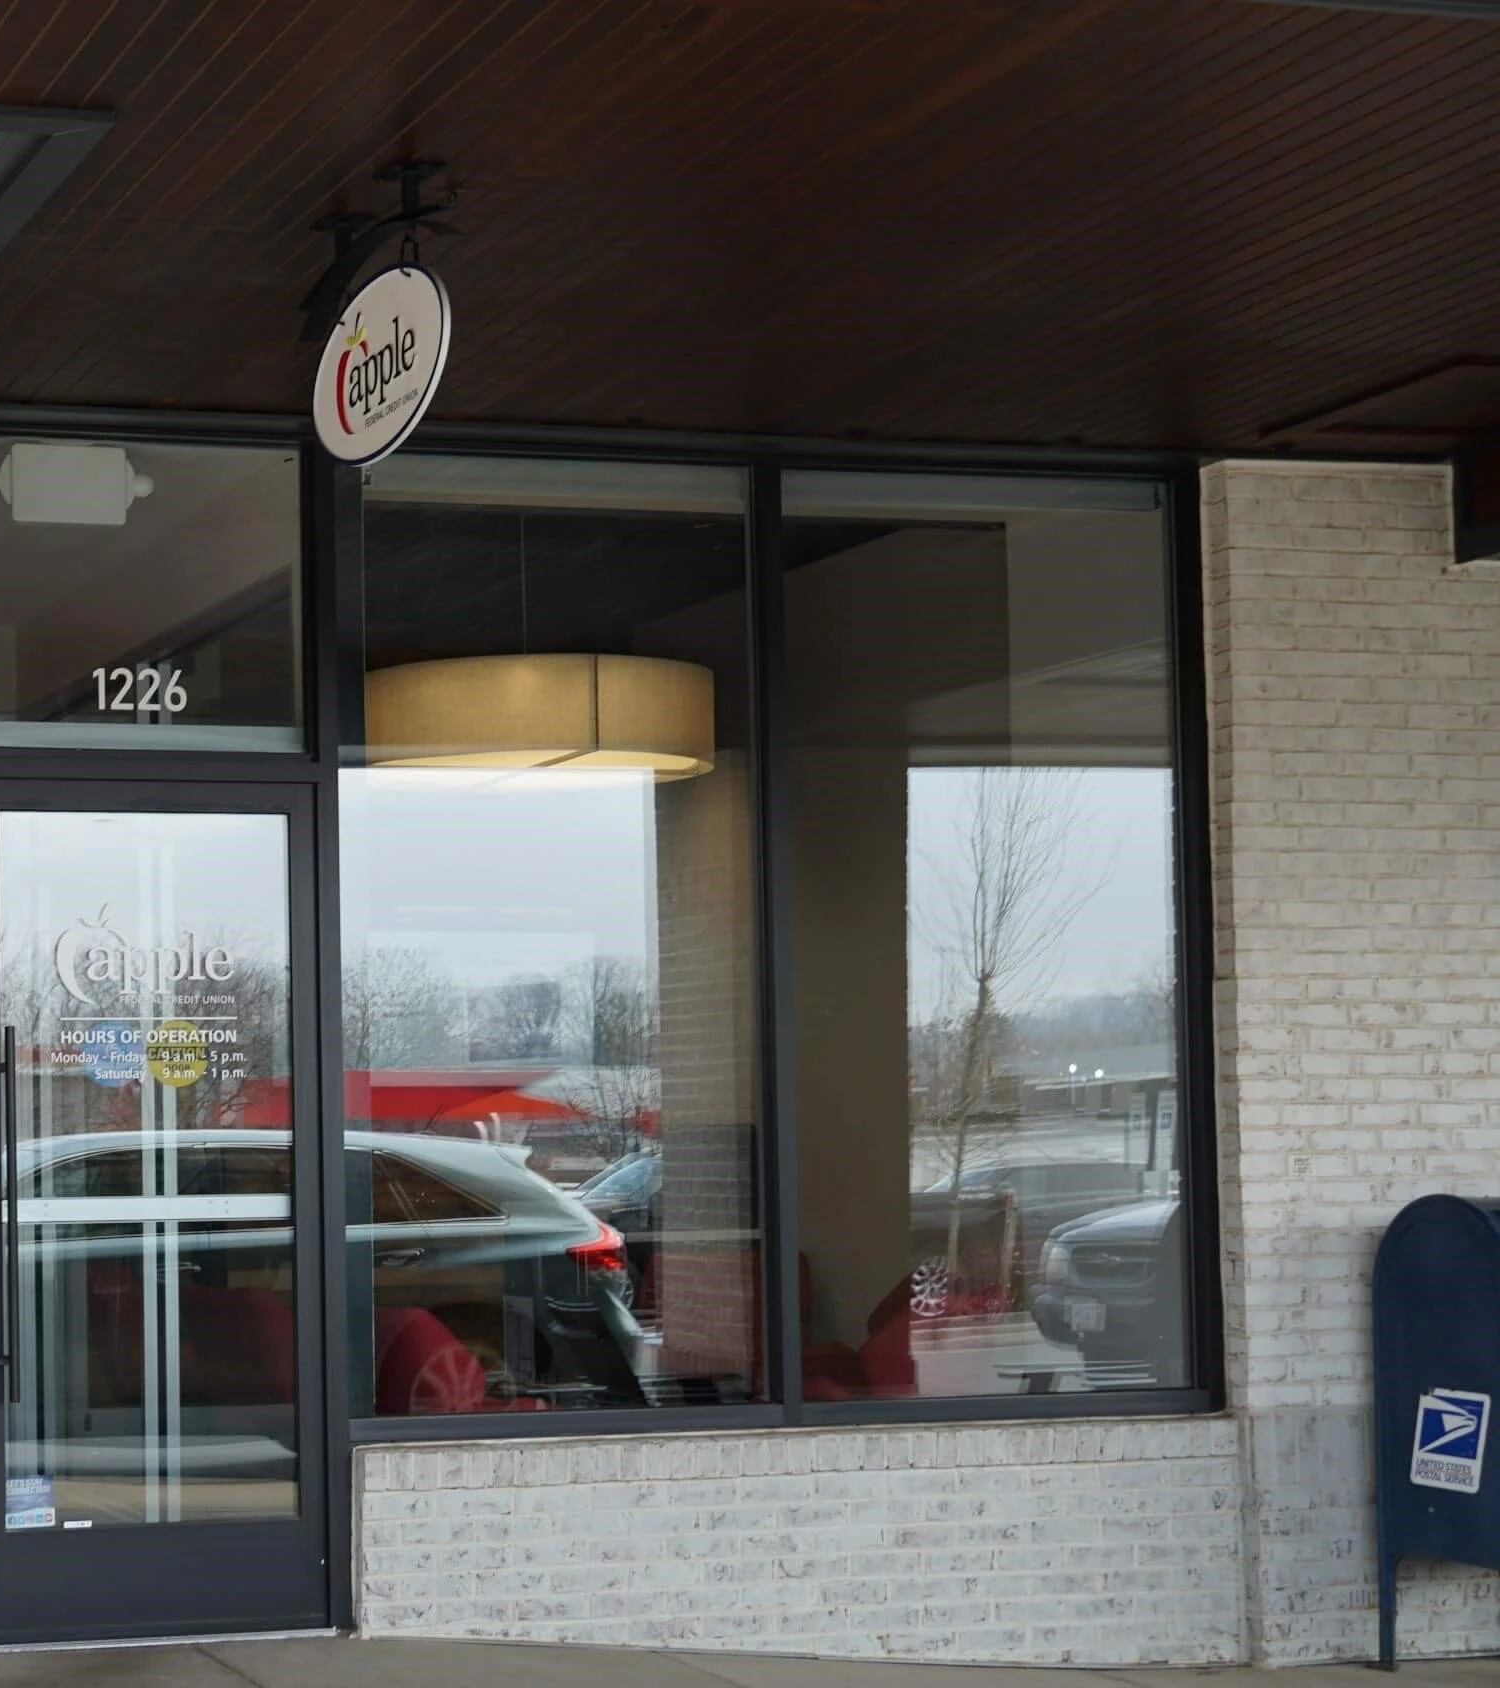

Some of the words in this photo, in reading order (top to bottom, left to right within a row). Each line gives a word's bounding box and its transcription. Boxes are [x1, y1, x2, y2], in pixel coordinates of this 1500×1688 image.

[349, 316, 416, 415] apple
[364, 410, 385, 428] FEDERAL
[385, 397, 402, 418] CREDIT
[402, 388, 419, 408] UNION
[92, 667, 188, 712] 1226
[86, 931, 235, 995] apple
[119, 995, 163, 1005] FEDAL
[202, 995, 235, 1004] UNION
[60, 1030, 116, 1044] HOURS
[120, 1030, 141, 1043] OF
[147, 1029, 237, 1043] OPERATION
[51, 1051, 99, 1065] Monday
[110, 1051, 147, 1065] Friday
[162, 1051, 169, 1062] 9
[210, 1051, 217, 1062] 5
[221, 1052, 247, 1064] p.m.
[95, 1068, 147, 1083] Saturday
[162, 1068, 169, 1079] 9
[173, 1069, 198, 1079] a.m.
[211, 1068, 217, 1078] 1
[221, 1069, 247, 1080] p.m.
[1415, 1457, 1444, 1471] UNITED
[1443, 1461, 1473, 1474] STATES
[1415, 1470, 1441, 1481] POSTAL
[1443, 1474, 1475, 1487] SERVICE
